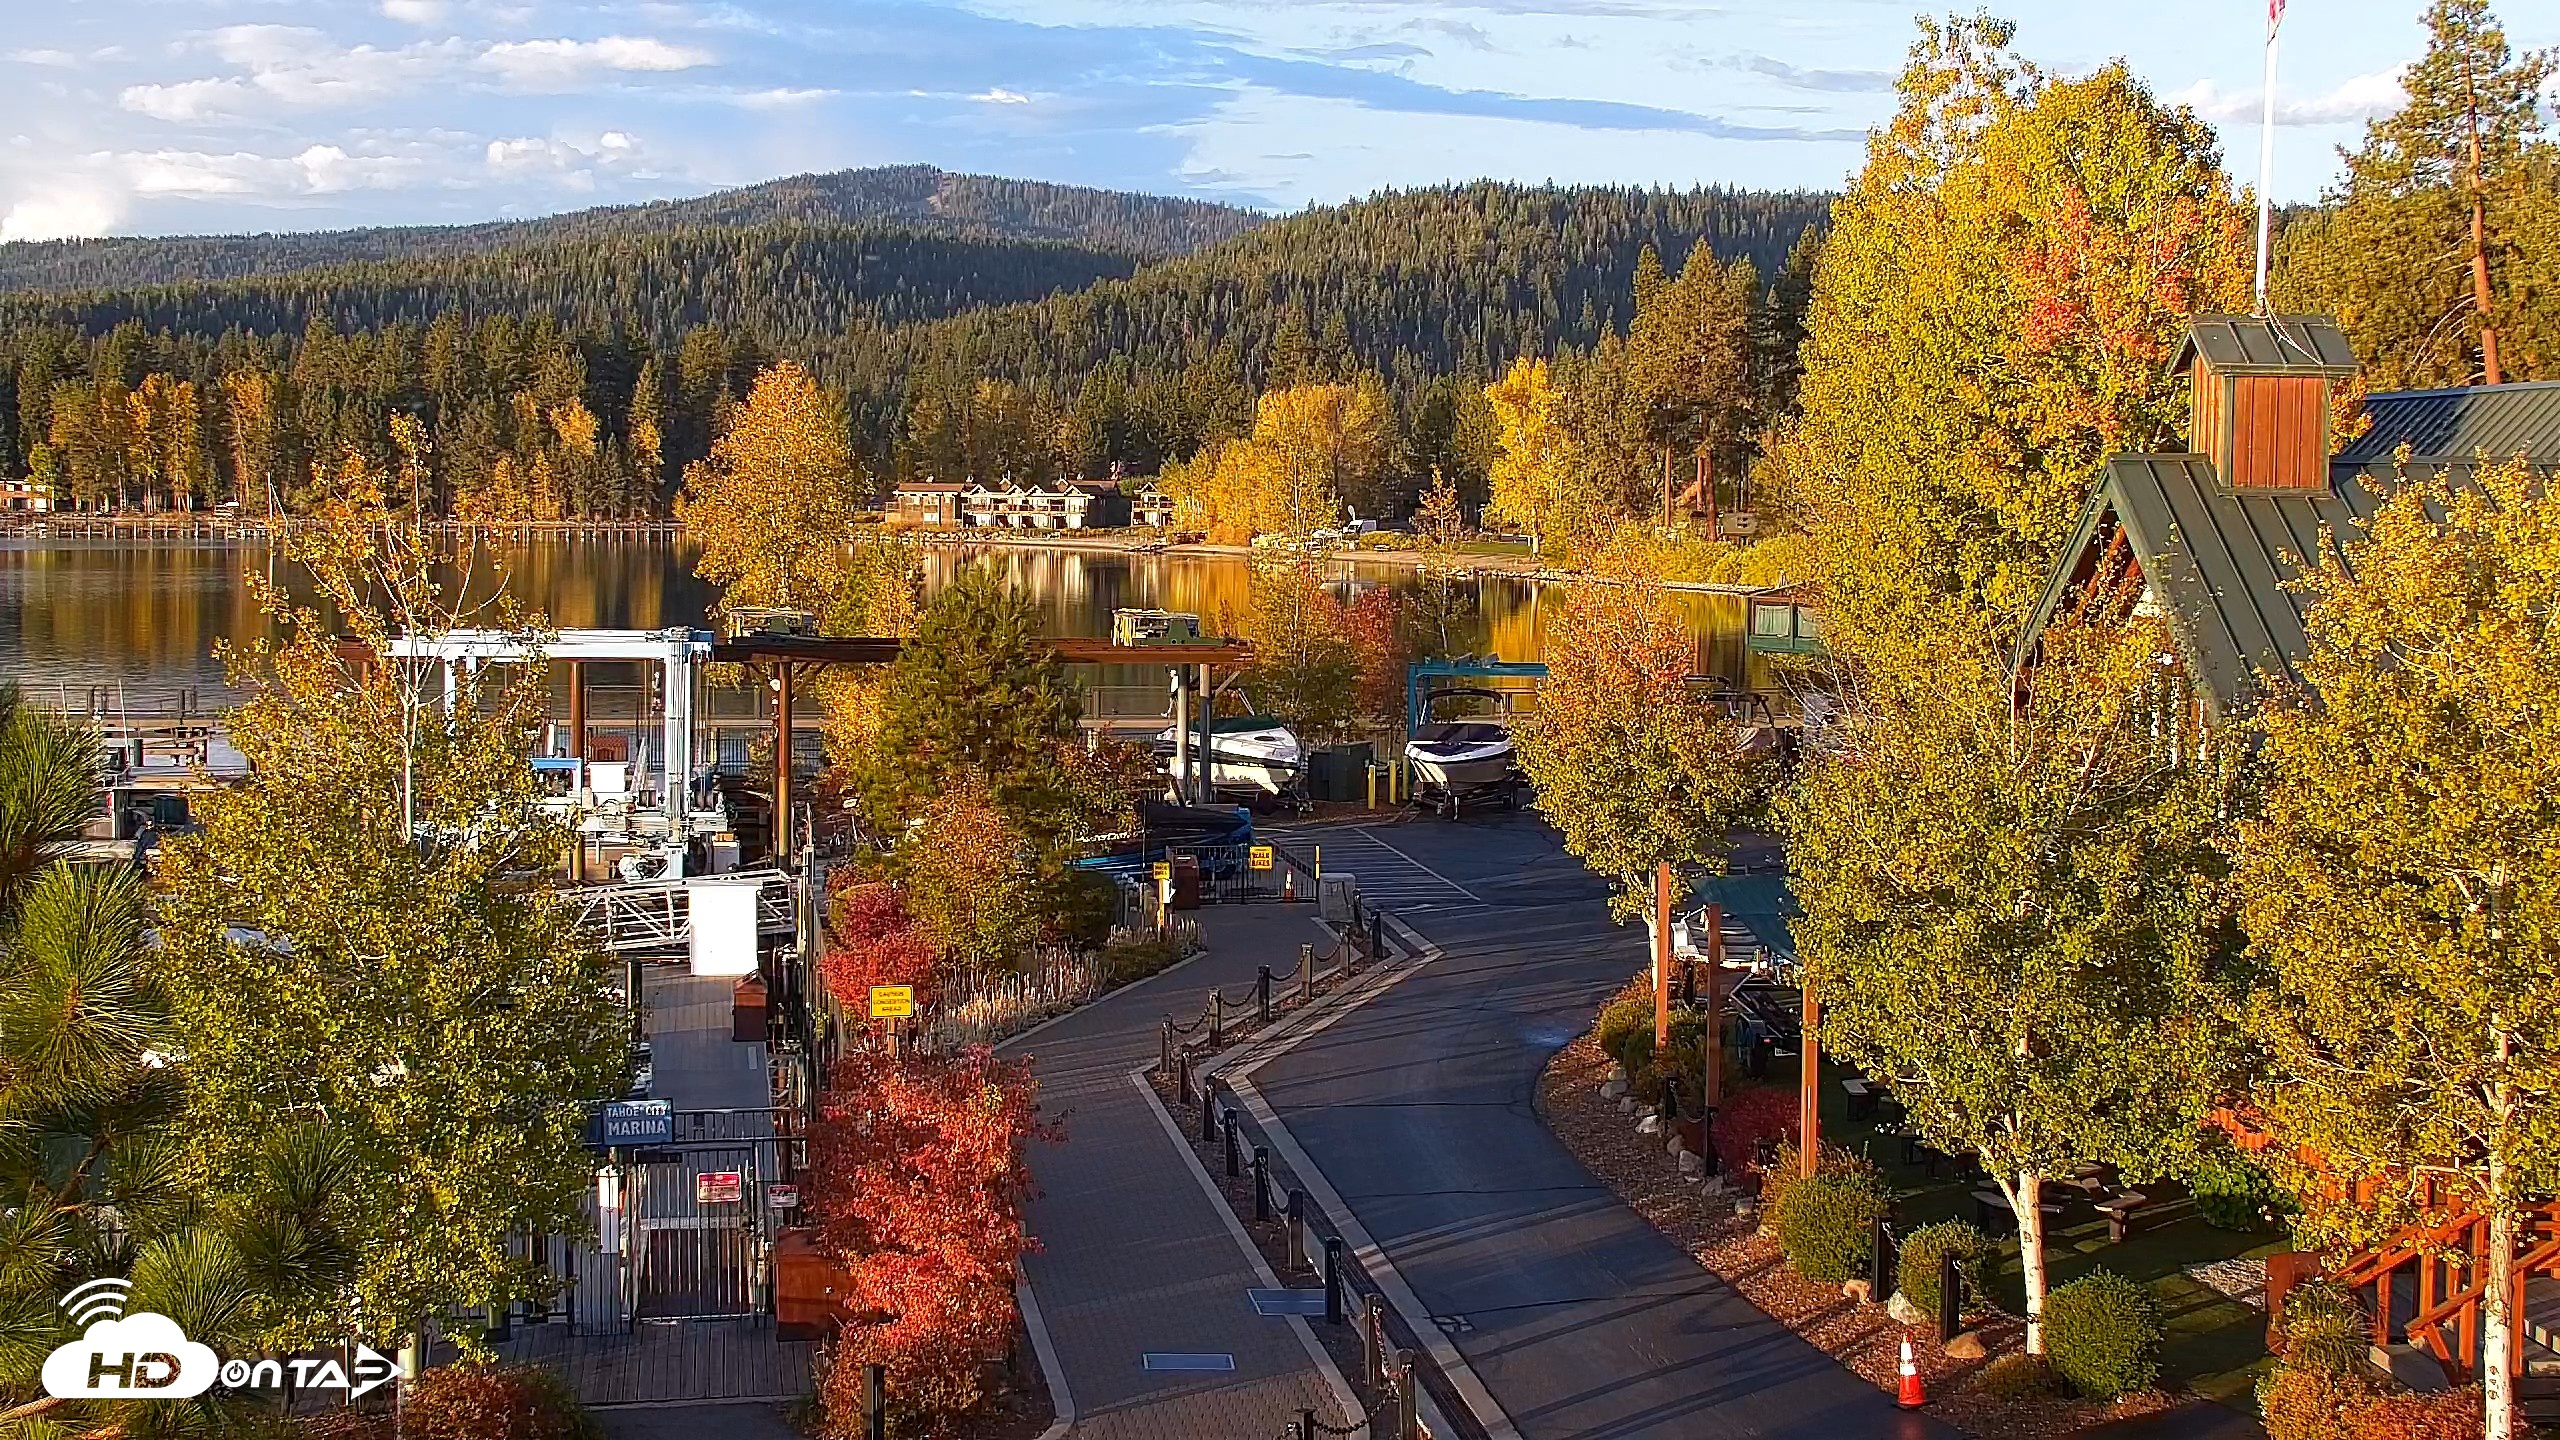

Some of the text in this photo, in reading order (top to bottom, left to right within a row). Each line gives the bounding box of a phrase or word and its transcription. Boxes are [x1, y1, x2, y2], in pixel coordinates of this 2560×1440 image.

[607, 1104, 669, 1117] TAHOE CITY
[607, 1120, 667, 1136] MARINA
